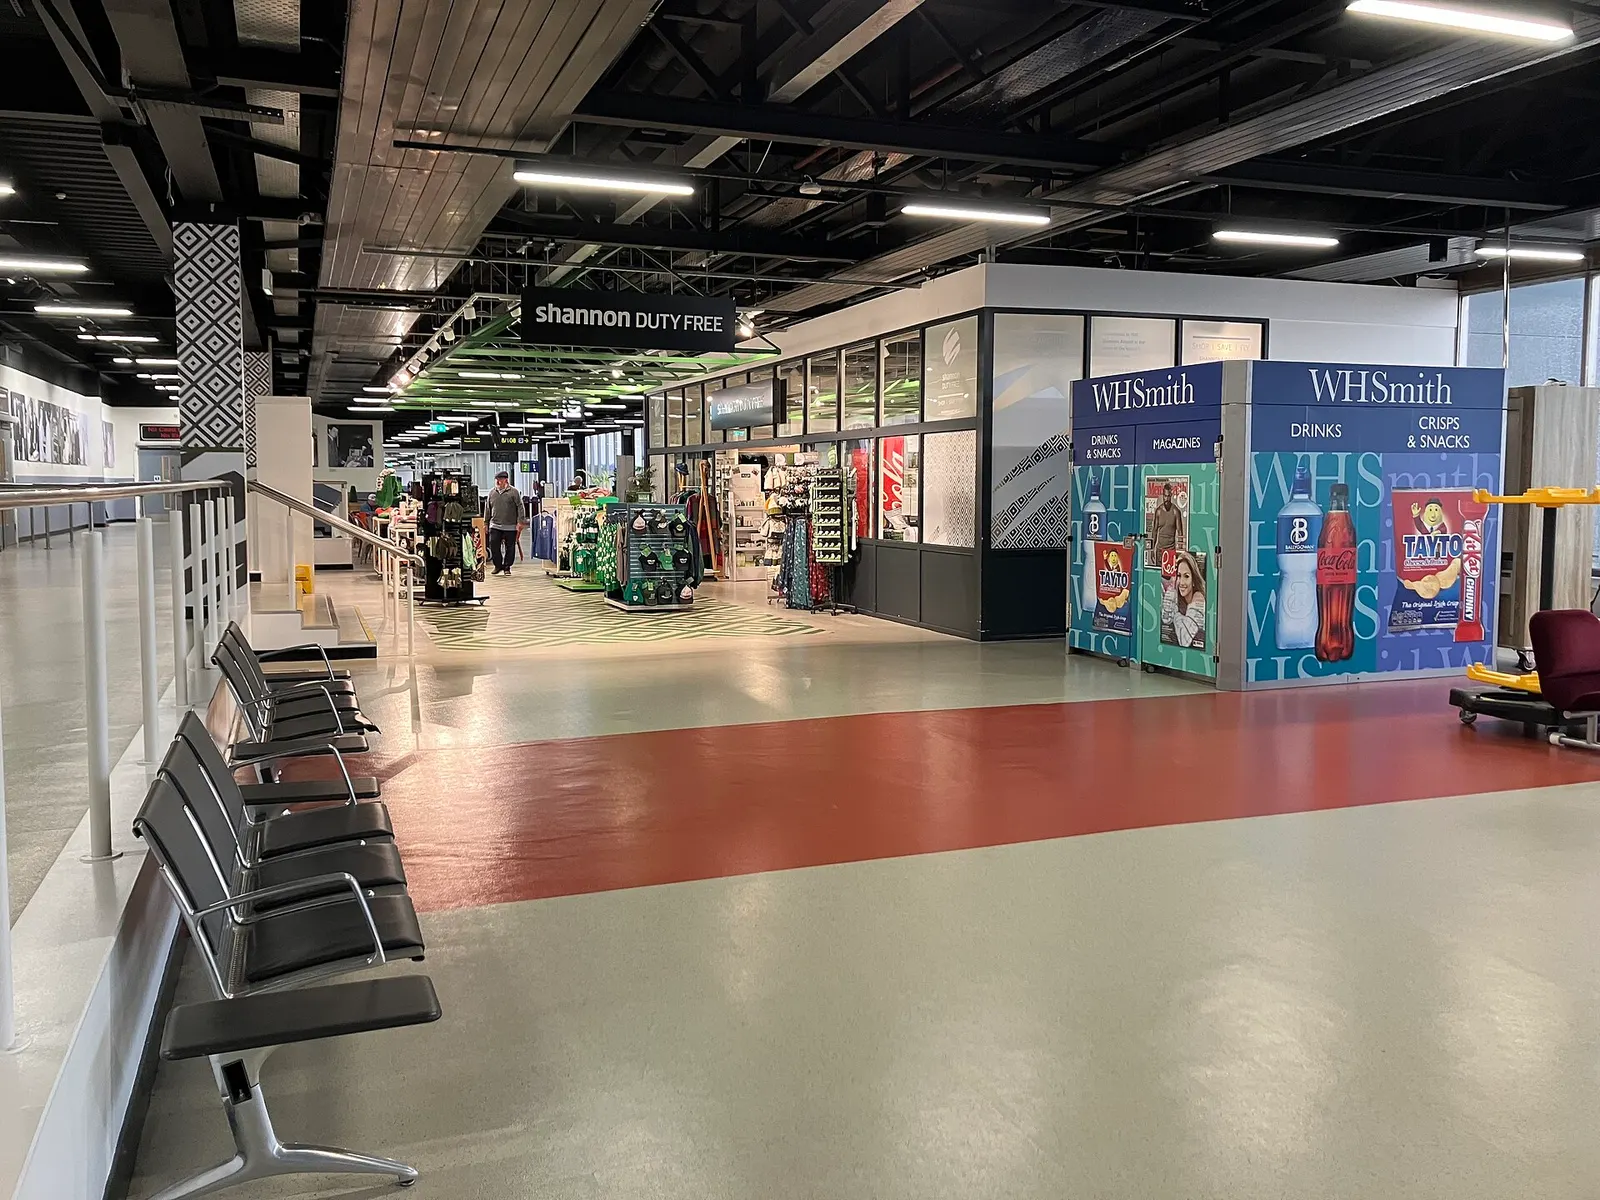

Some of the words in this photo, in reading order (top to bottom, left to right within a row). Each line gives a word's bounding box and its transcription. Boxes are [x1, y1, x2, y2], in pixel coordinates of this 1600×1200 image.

[535, 303, 630, 327] shannon
[635, 312, 681, 330] DUTY
[683, 314, 724, 332] FREE
[1091, 372, 1195, 413] WHSmith
[1308, 369, 1453, 405] WHSmith
[1290, 423, 1342, 438] DRINKS
[1418, 416, 1460, 430] CRISPS
[1091, 434, 1118, 446] DRINKS
[1153, 437, 1201, 450] MAGAZINES
[1407, 435, 1416, 448] &
[1419, 434, 1470, 448] SNACKS
[1086, 449, 1092, 459] &
[1093, 447, 1121, 459] SNACKS
[1403, 534, 1462, 559] TAYTO
[1161, 550, 1178, 574] Red
[1099, 570, 1128, 589] TAYTO
[1412, 600, 1433, 610] Original
[1465, 578, 1475, 620] CHUNKY
